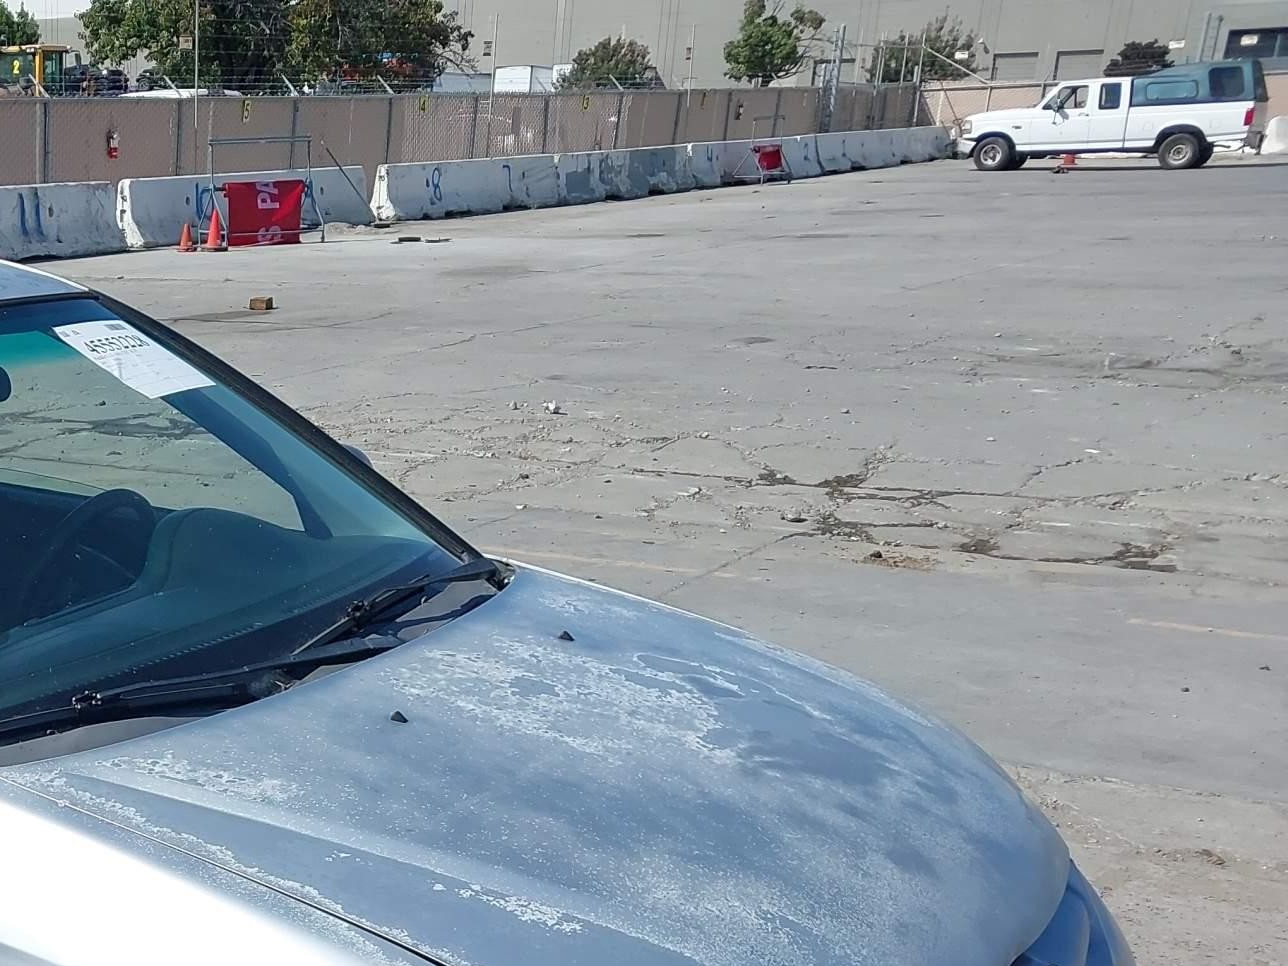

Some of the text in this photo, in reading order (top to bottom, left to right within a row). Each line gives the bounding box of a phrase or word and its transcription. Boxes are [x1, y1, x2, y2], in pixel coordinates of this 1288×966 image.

[13, 60, 20, 74] 2
[244, 102, 250, 119] 5
[83, 334, 150, 354] 45552228
